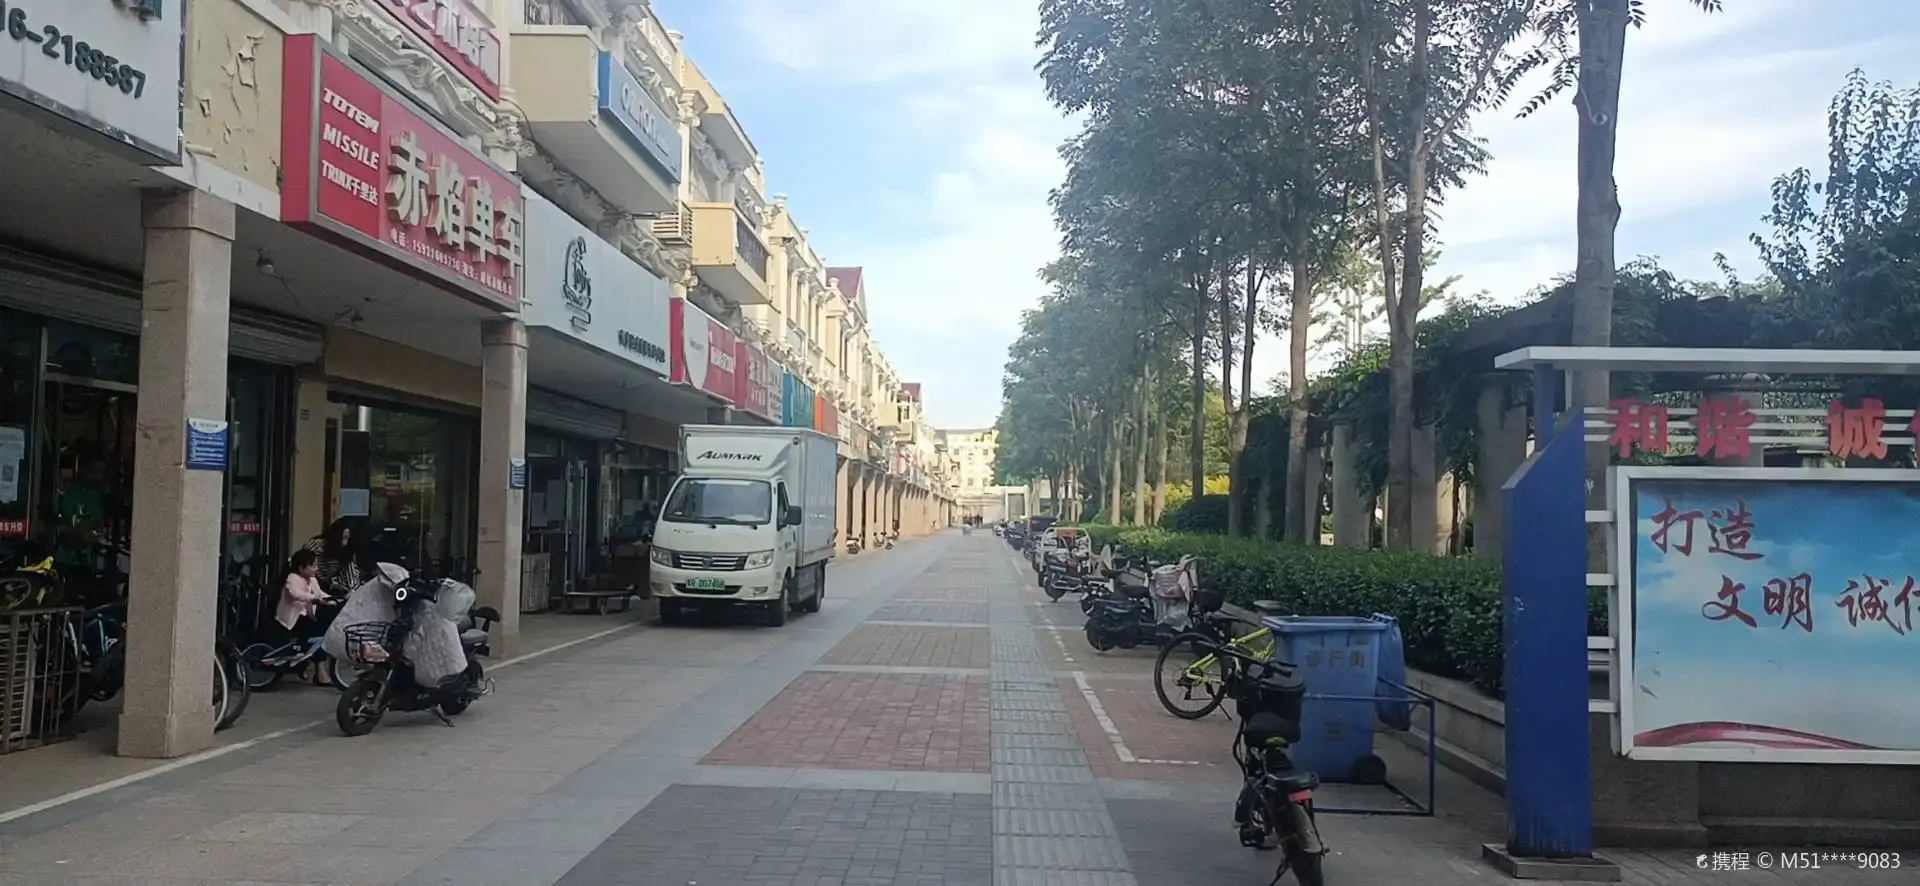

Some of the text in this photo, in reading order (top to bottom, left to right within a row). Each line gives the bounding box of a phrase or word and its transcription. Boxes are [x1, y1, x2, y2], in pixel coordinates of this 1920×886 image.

[323, 87, 380, 134] TOTEM
[323, 123, 380, 171] MISSILE
[385, 130, 522, 279] 赤焰单车
[696, 450, 763, 462] AUMARK
[1607, 393, 1920, 460] 和谐 诚
[1651, 497, 1765, 561] 打造
[1701, 572, 1813, 633] 文明
